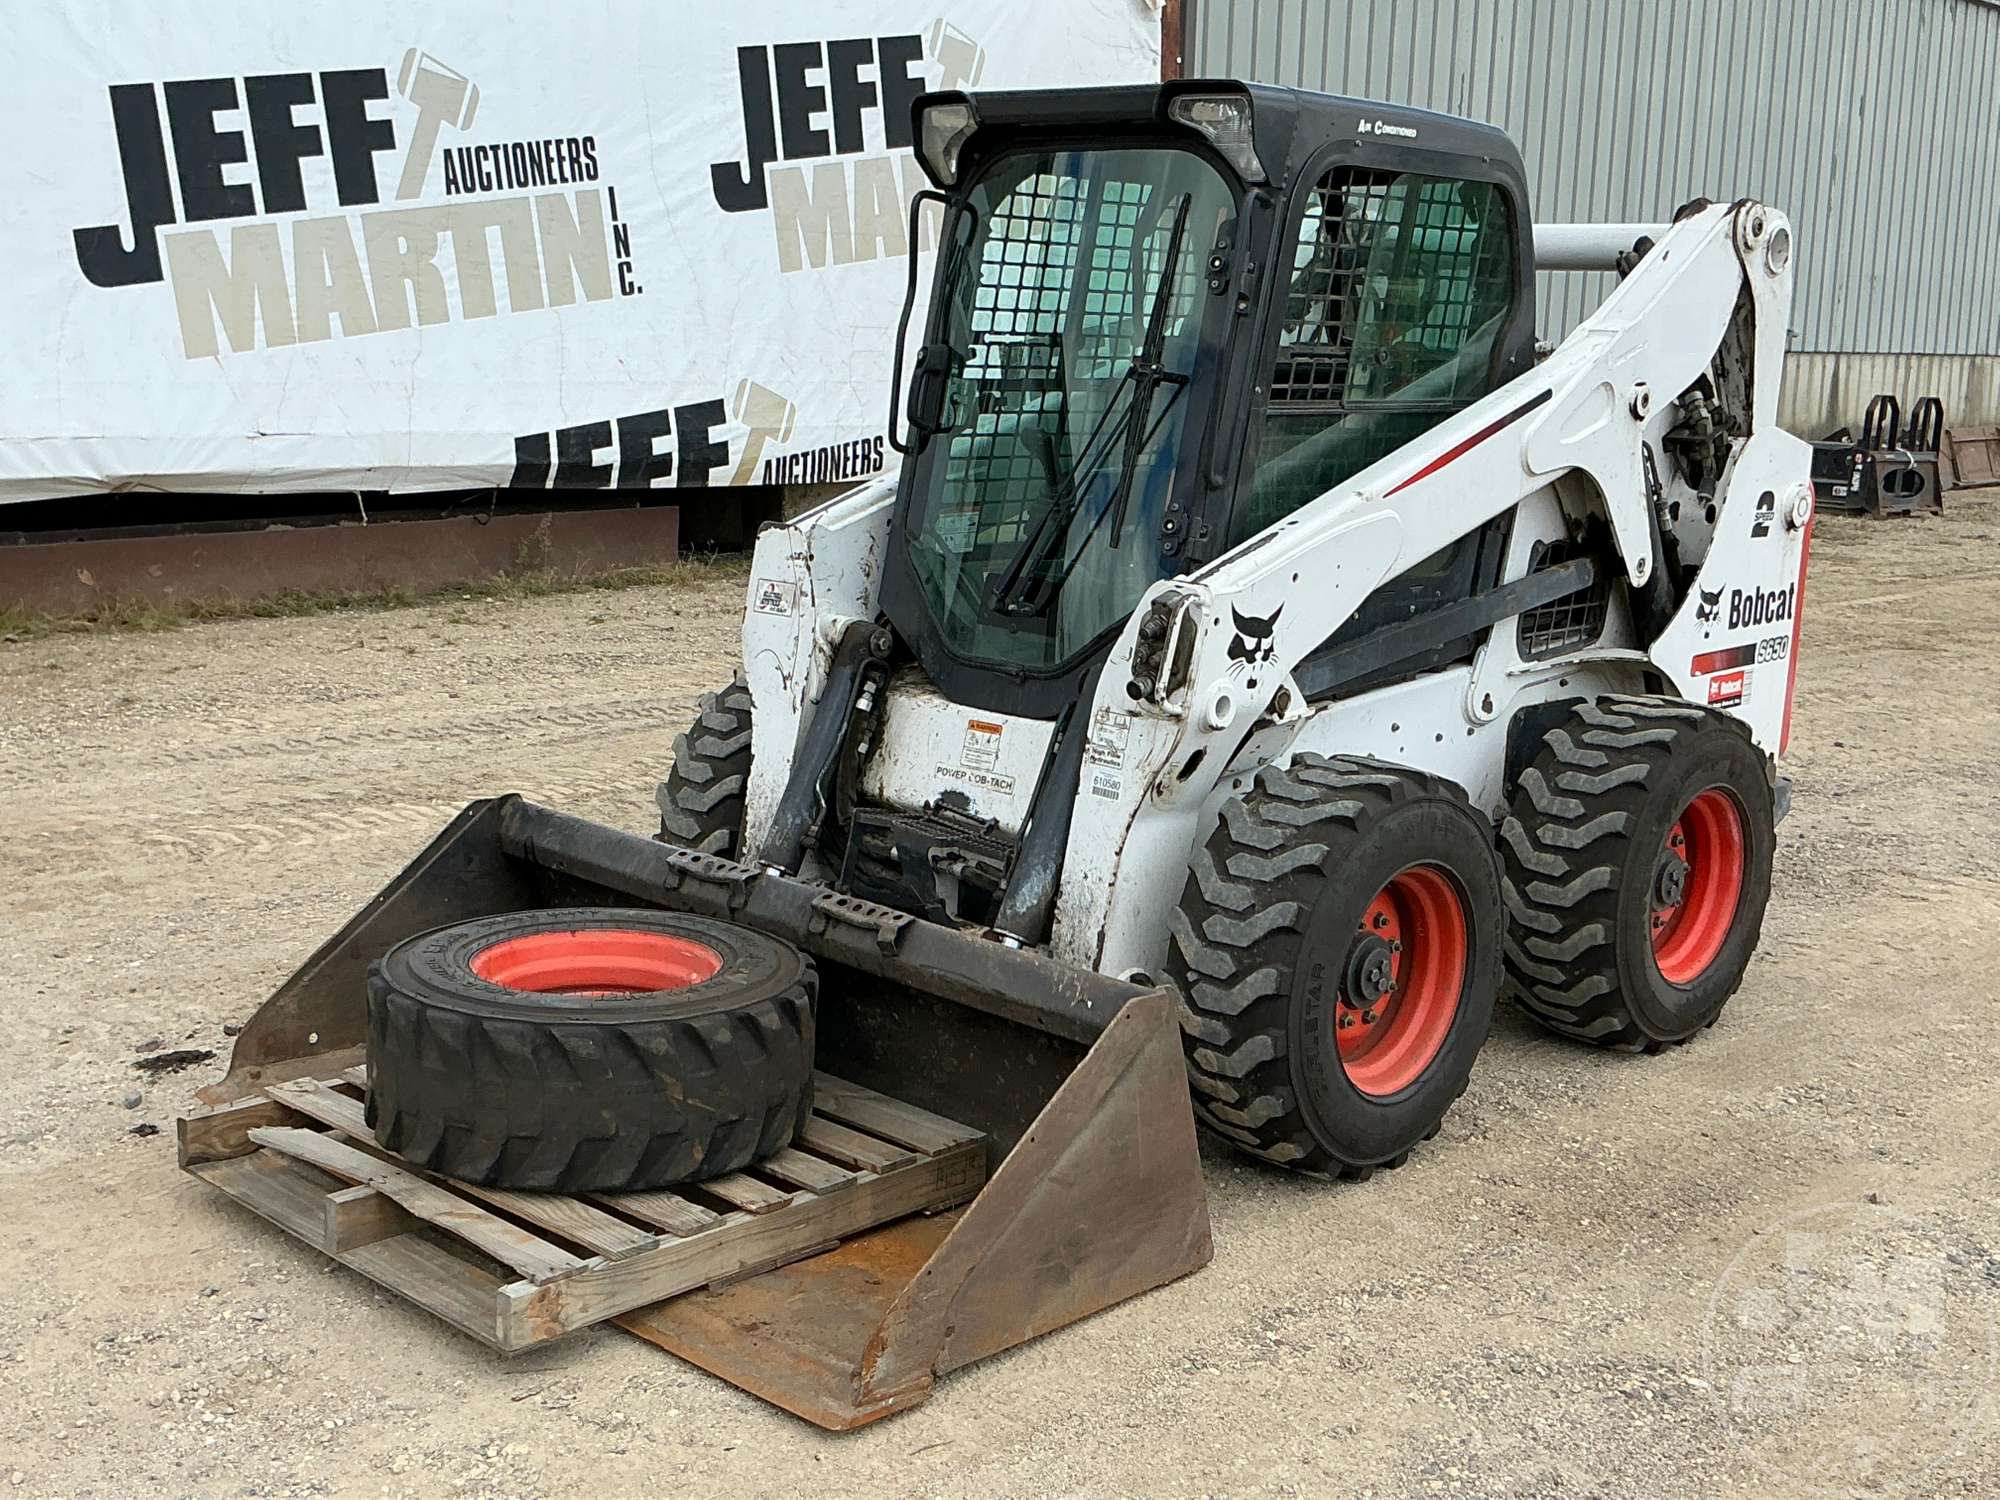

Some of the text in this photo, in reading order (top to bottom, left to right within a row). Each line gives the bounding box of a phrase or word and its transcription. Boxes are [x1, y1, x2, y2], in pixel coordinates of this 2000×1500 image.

[710, 35, 926, 212] JEFF
[73, 68, 396, 287] JEFF
[443, 136, 600, 195] AUCTIONEERS
[164, 189, 614, 360] MARTIN
[762, 436, 884, 485] AUCTIONEERS
[1728, 582, 1795, 630] Bobcat
[1757, 635, 1789, 664] S650
[1093, 775, 1121, 791] 610580
